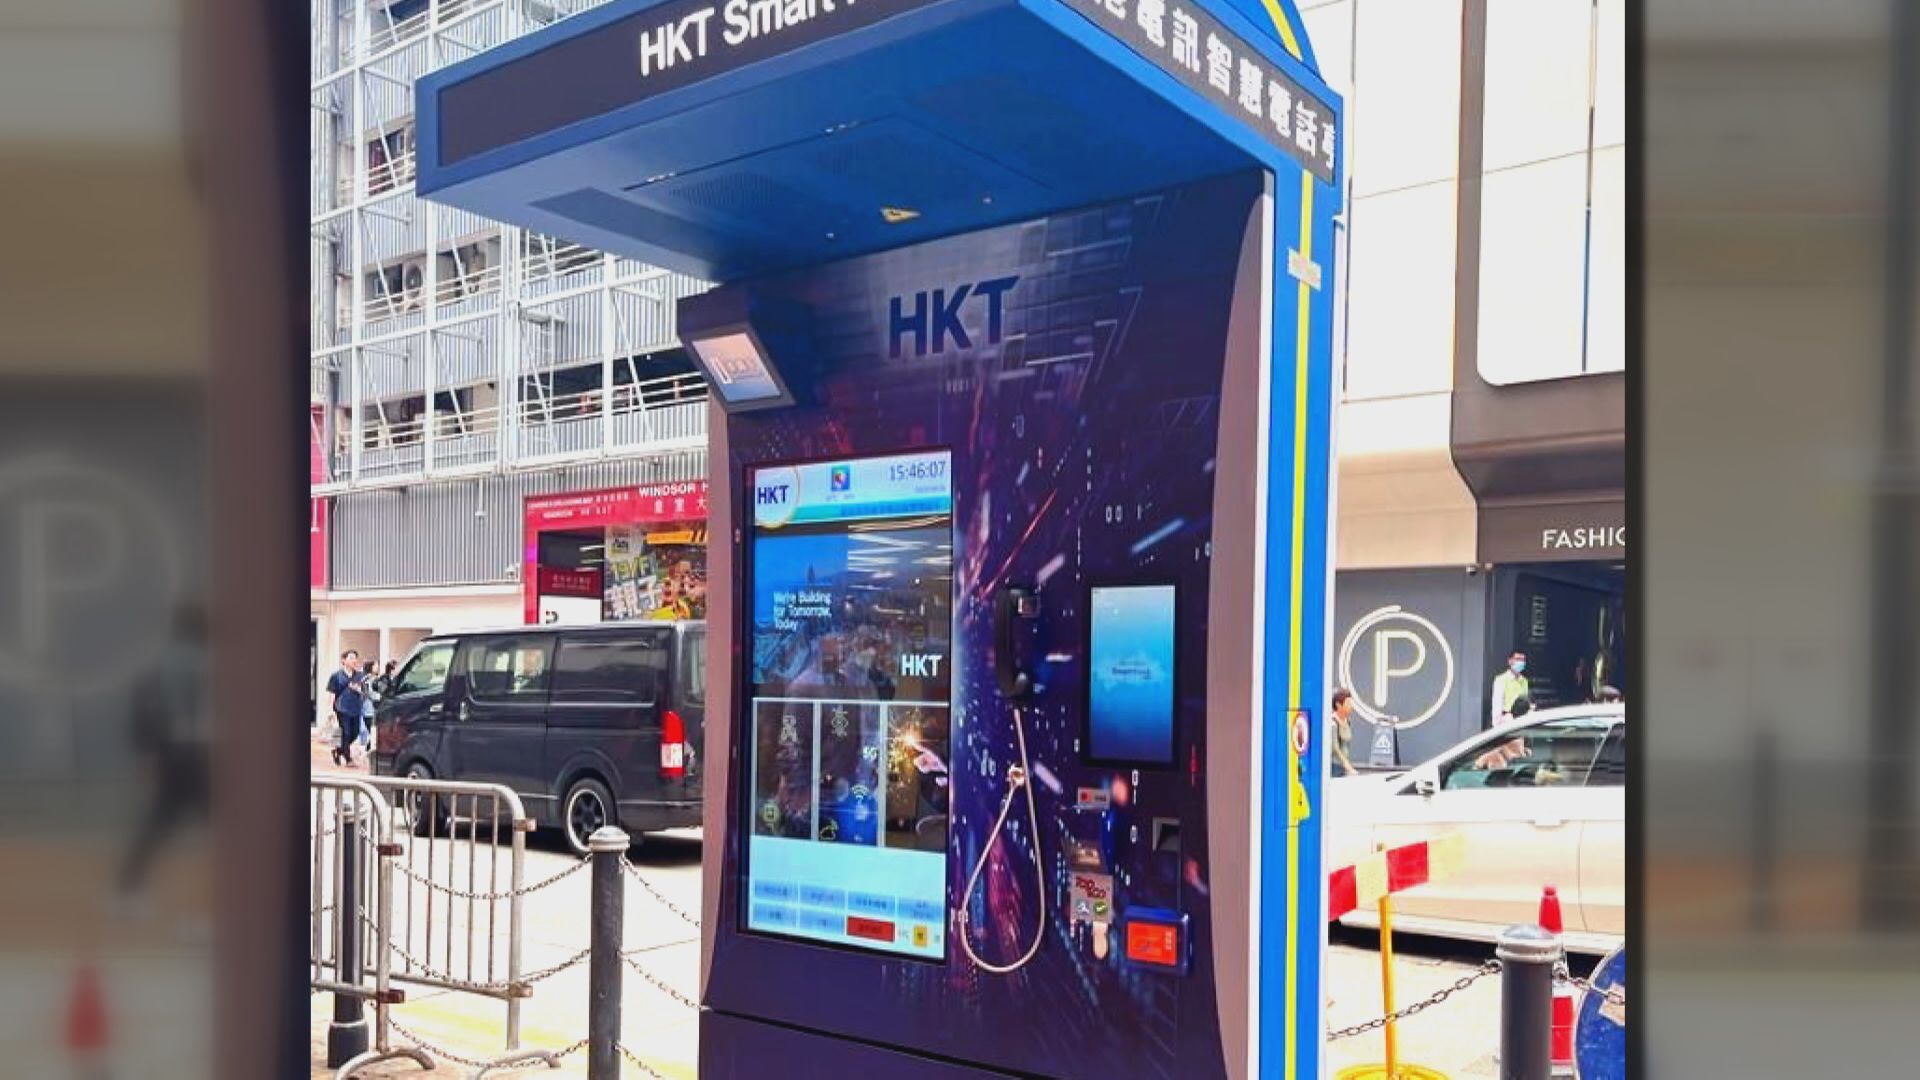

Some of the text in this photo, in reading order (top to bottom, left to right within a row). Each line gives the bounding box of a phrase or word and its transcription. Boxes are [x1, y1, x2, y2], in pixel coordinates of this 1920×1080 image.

[640, 0, 836, 77] HKT Smar
[888, 275, 1020, 358] HKT
[889, 460, 947, 482] 15:46:07
[639, 482, 696, 499] WINDSOR
[757, 484, 789, 504] HKT
[901, 654, 942, 677] HKT
[1374, 630, 1426, 707] P
